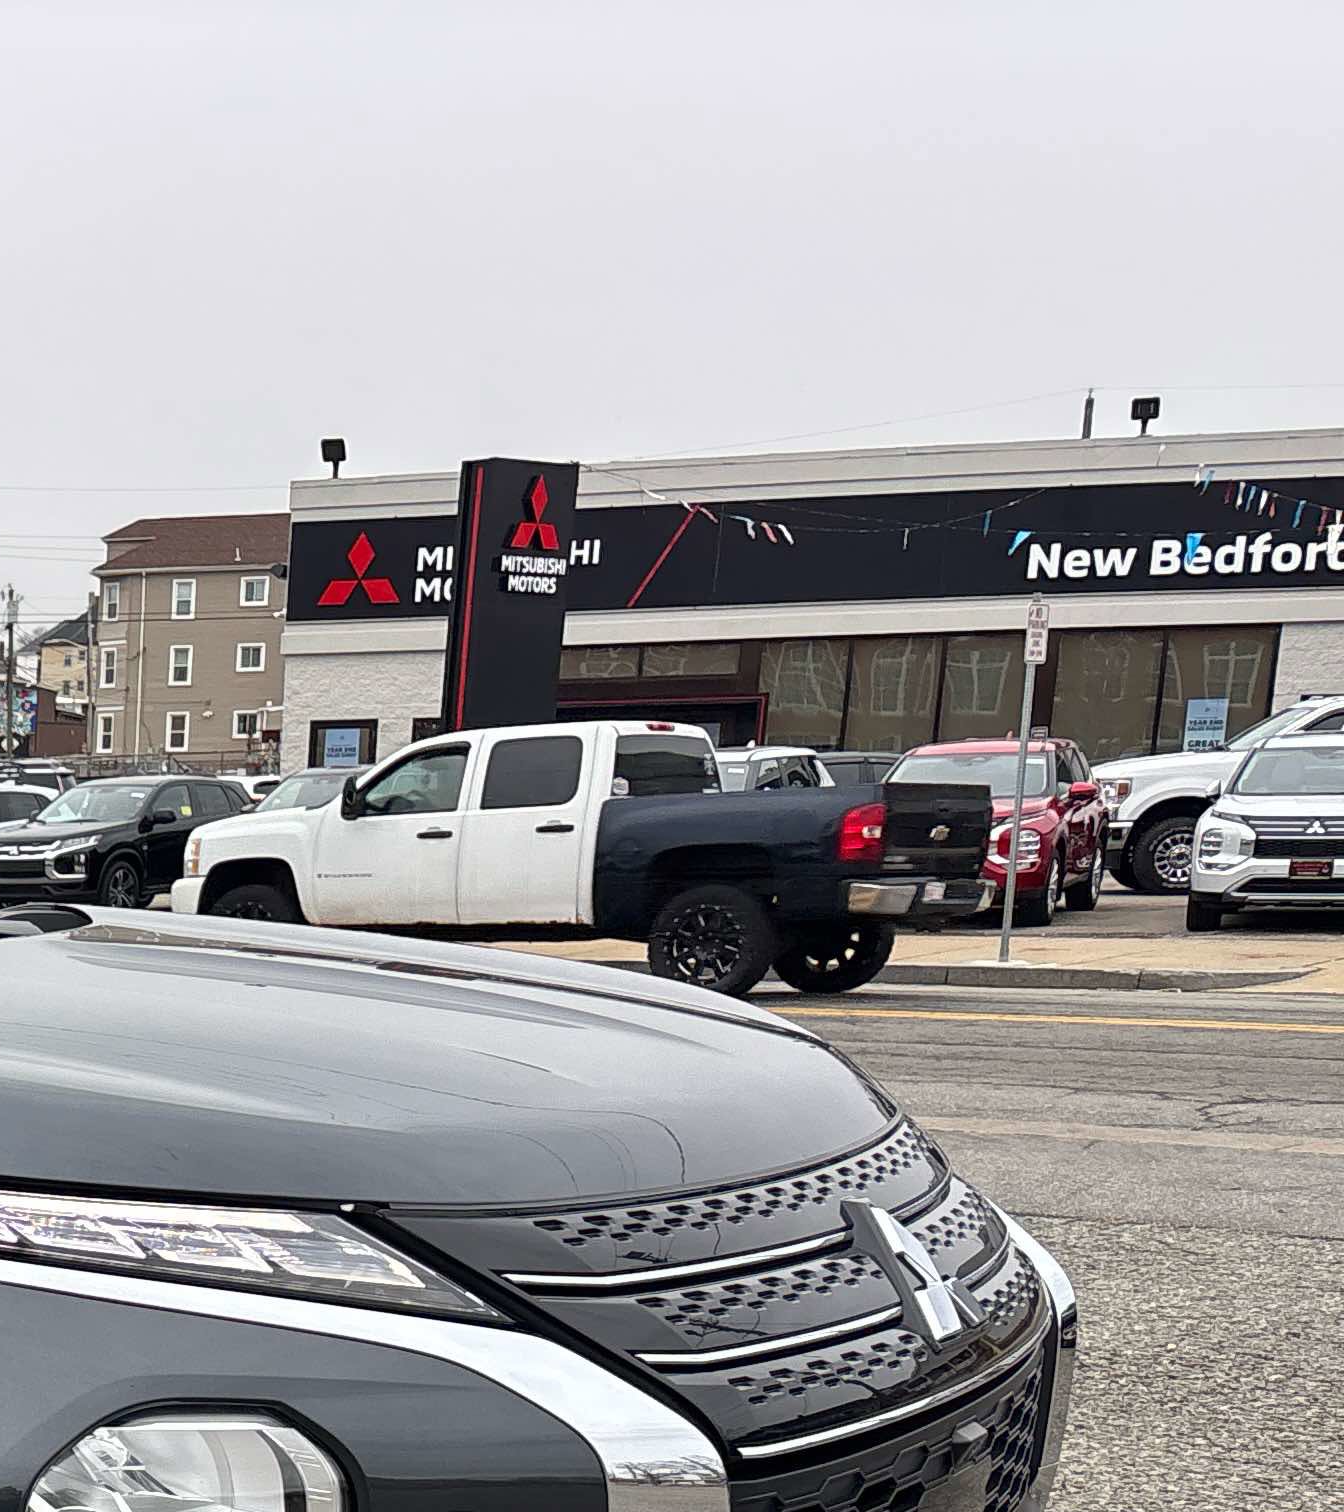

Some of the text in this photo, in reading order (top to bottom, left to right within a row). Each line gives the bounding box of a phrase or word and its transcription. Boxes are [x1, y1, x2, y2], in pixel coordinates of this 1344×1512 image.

[500, 554, 567, 575] MITSUBISHI
[1026, 542, 1138, 579] New
[507, 574, 557, 594] MOTORS
[1187, 739, 1221, 748] GREAT
